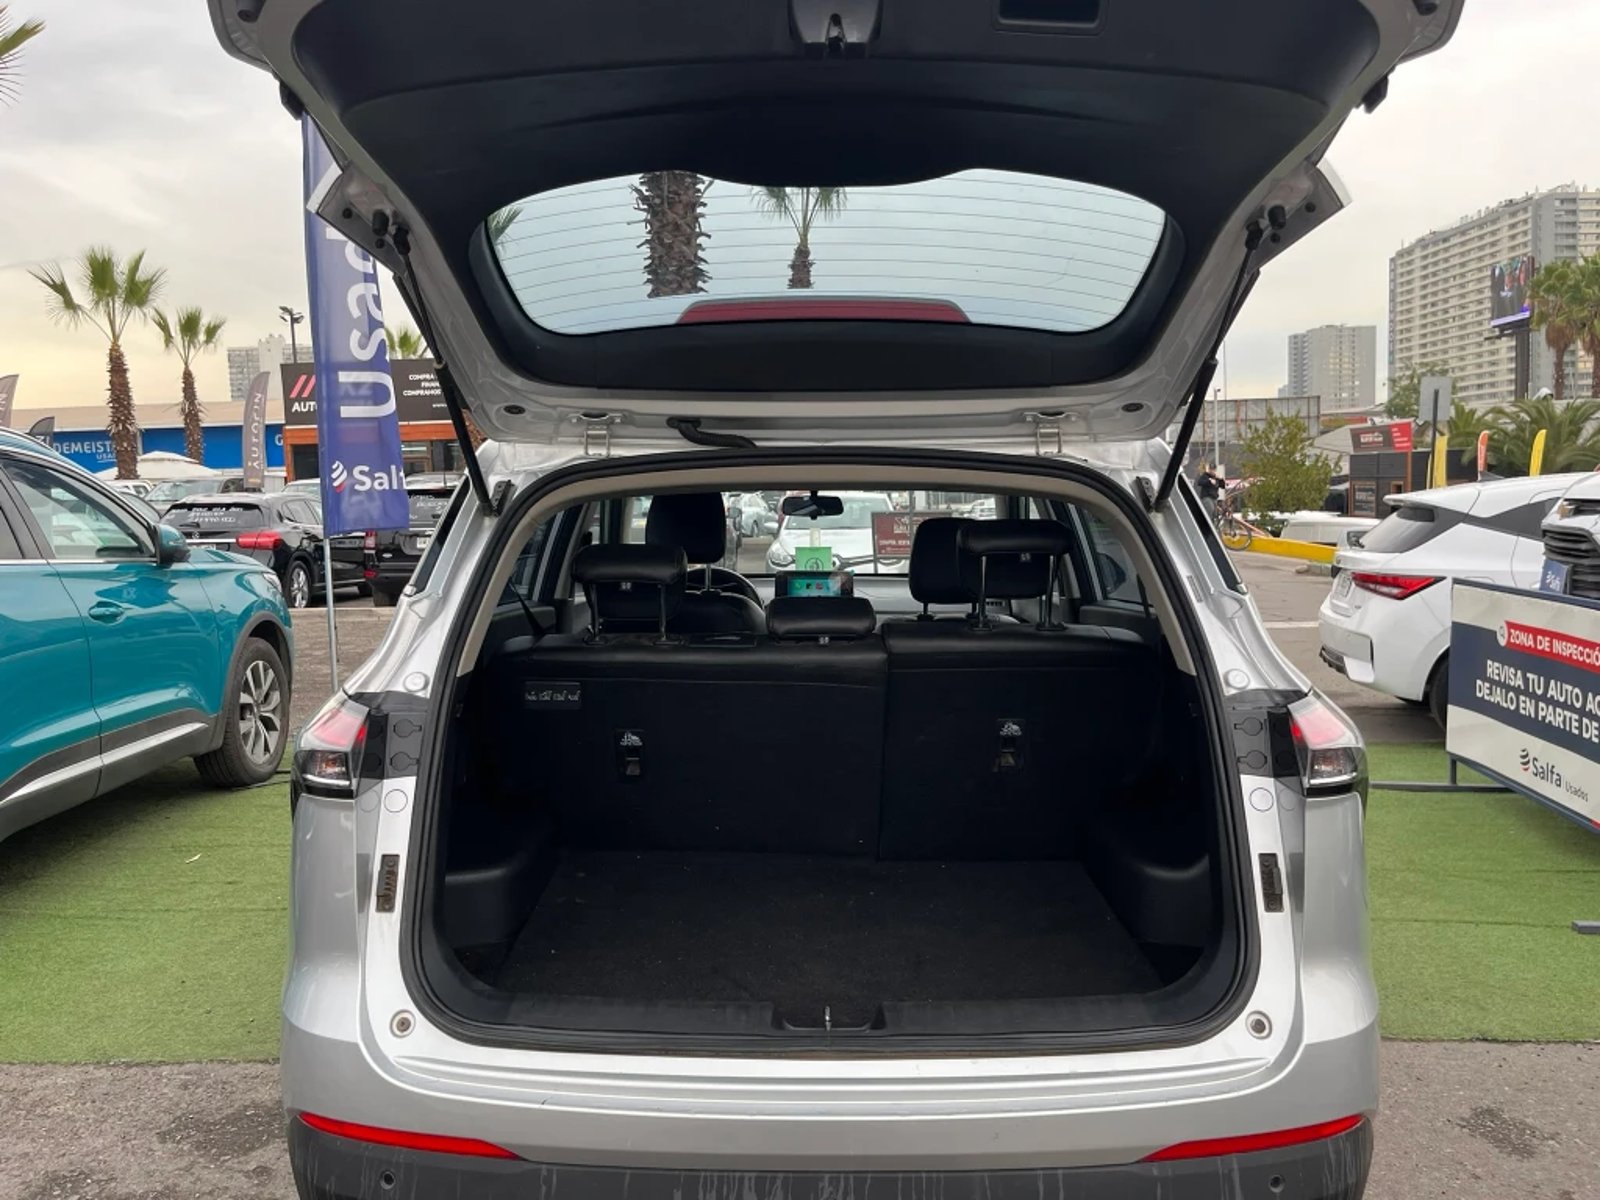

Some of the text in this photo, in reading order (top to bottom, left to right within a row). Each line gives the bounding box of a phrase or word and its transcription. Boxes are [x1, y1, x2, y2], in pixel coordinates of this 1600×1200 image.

[291, 401, 318, 413] AUT
[53, 440, 115, 454] DEMEIST
[1510, 628, 1535, 649] ZONA
[1536, 635, 1551, 652] DE
[1486, 659, 1525, 690] REVISA
[1526, 672, 1544, 696] TU
[1547, 679, 1582, 709] AUTO
[1476, 679, 1600, 744] DEJALO EN PARTE DE
[1532, 757, 1589, 802] Salfa Usados
